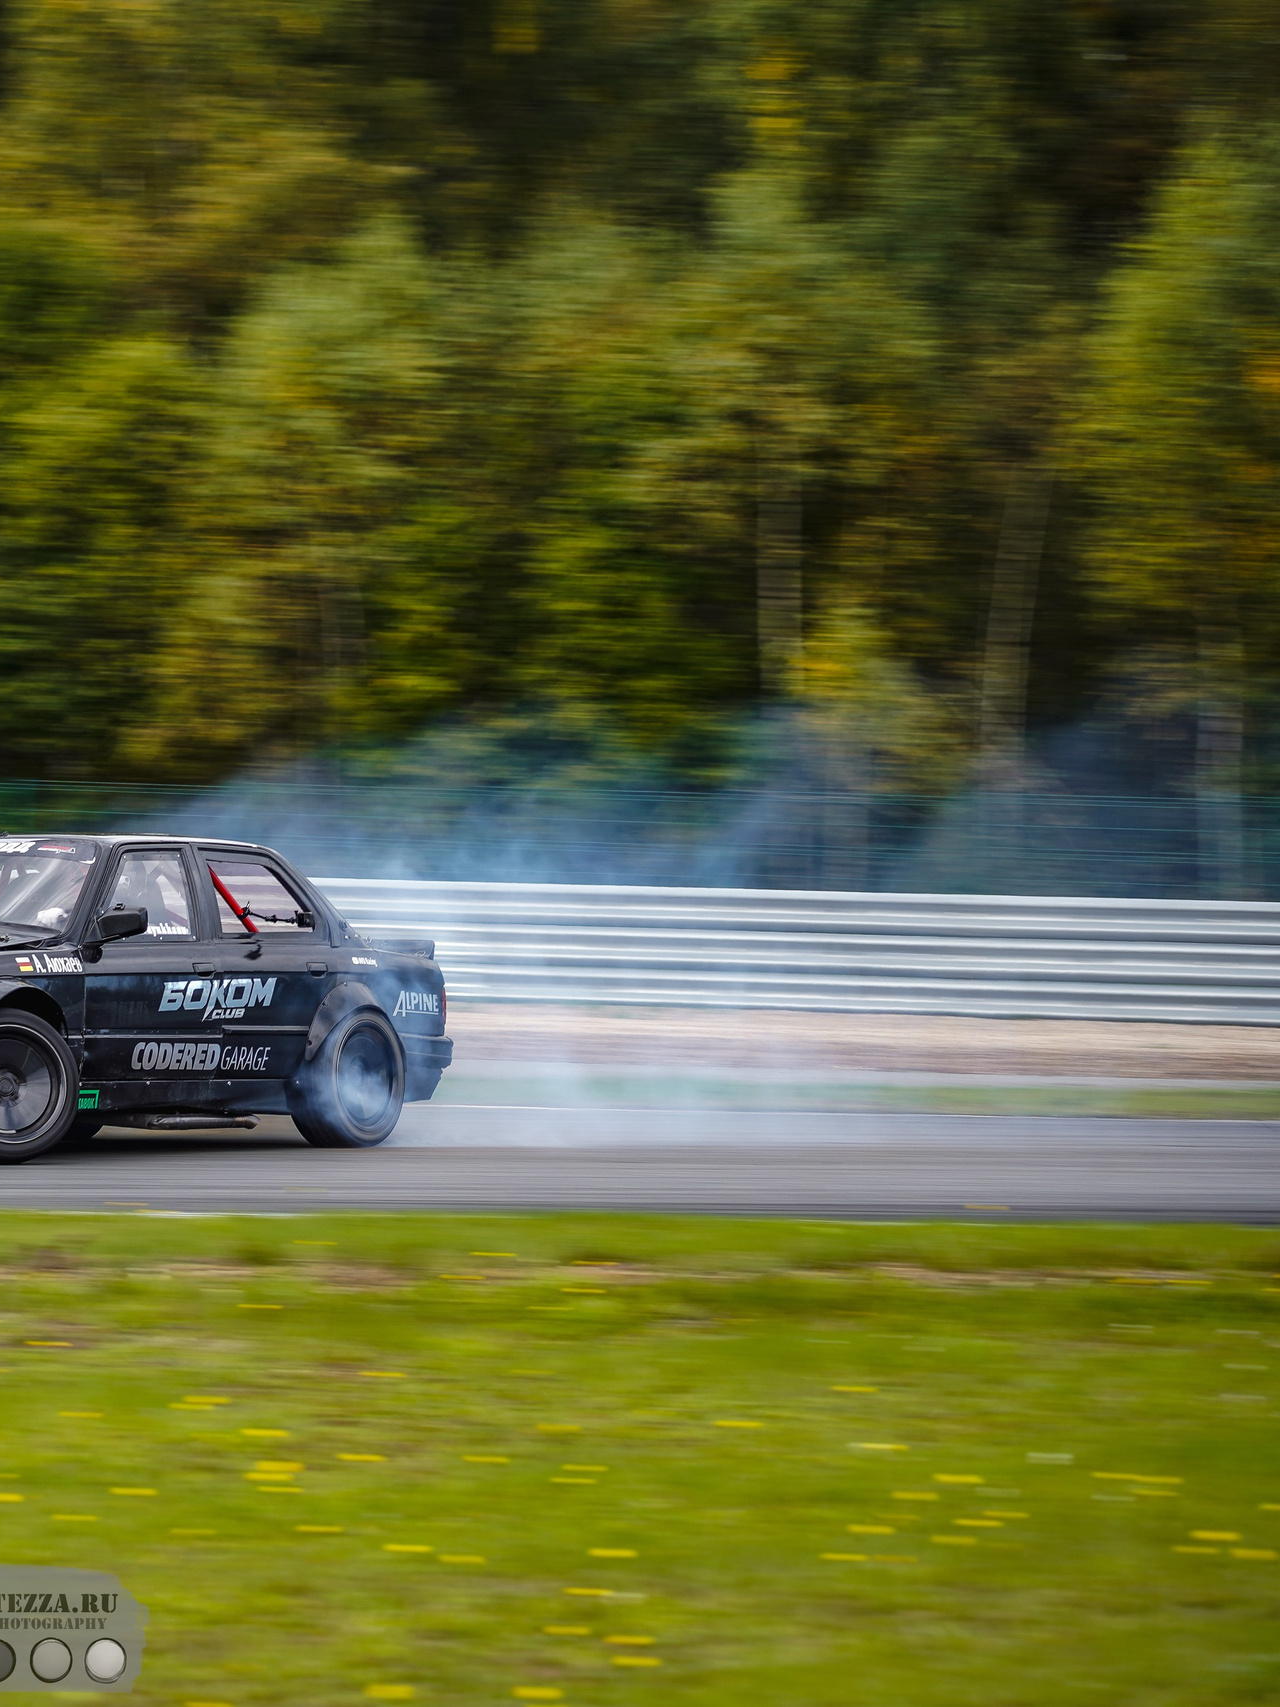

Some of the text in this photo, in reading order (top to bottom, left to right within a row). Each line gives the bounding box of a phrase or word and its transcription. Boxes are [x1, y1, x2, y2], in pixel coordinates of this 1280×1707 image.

[32, 953, 83, 973] А. Аюхаев
[158, 977, 277, 1022] БОКОМ
[392, 990, 439, 1017] ALPINE
[211, 1008, 246, 1019] CLUB
[131, 1041, 271, 1071] CODERED GARAGE
